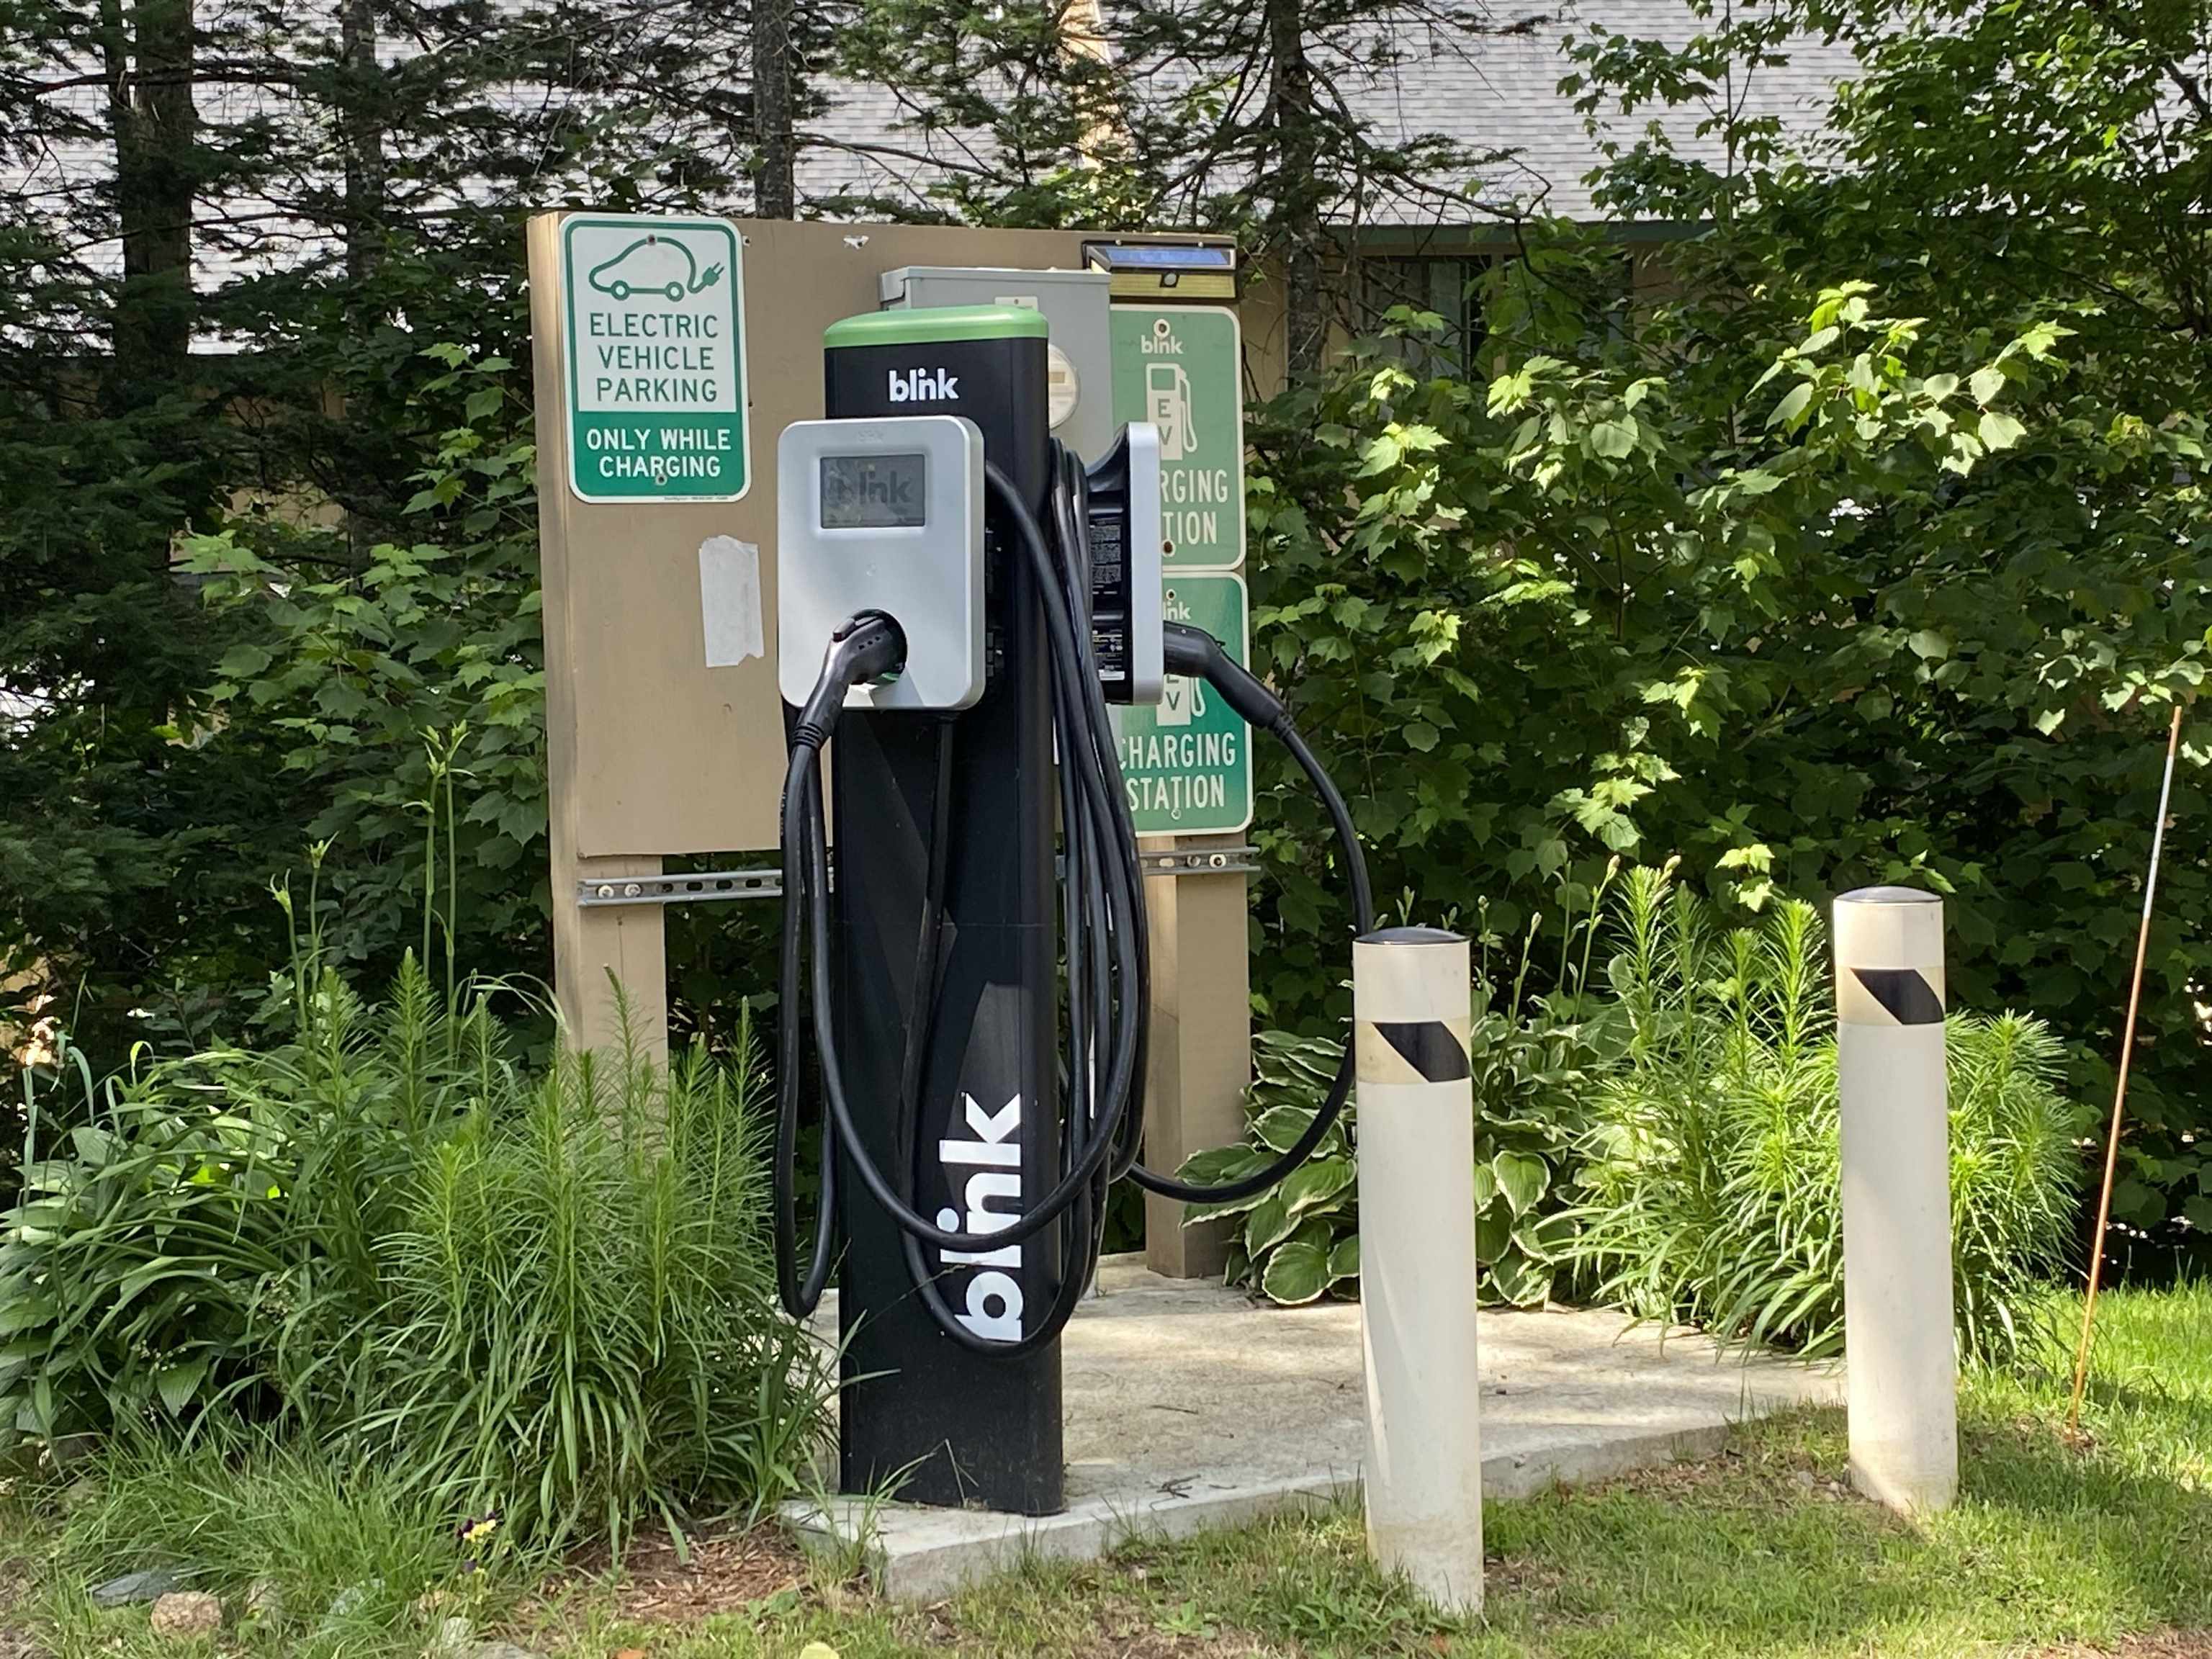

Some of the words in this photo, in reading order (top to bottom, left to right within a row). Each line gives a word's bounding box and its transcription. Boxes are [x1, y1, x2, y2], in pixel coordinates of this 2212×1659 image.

[590, 313, 719, 338] ELECTRIC
[598, 346, 714, 370] VEHICLE
[597, 378, 717, 403] PARKING
[888, 367, 959, 403] blink
[586, 428, 650, 451] ONLY
[660, 428, 732, 451] WHILE
[599, 456, 721, 478] CHARGING
[1161, 469, 1228, 503] RGING
[1162, 511, 1217, 544] TION
[1163, 601, 1191, 620] link
[1125, 774, 1225, 811] STATION
[936, 1092, 1024, 1341] blink
